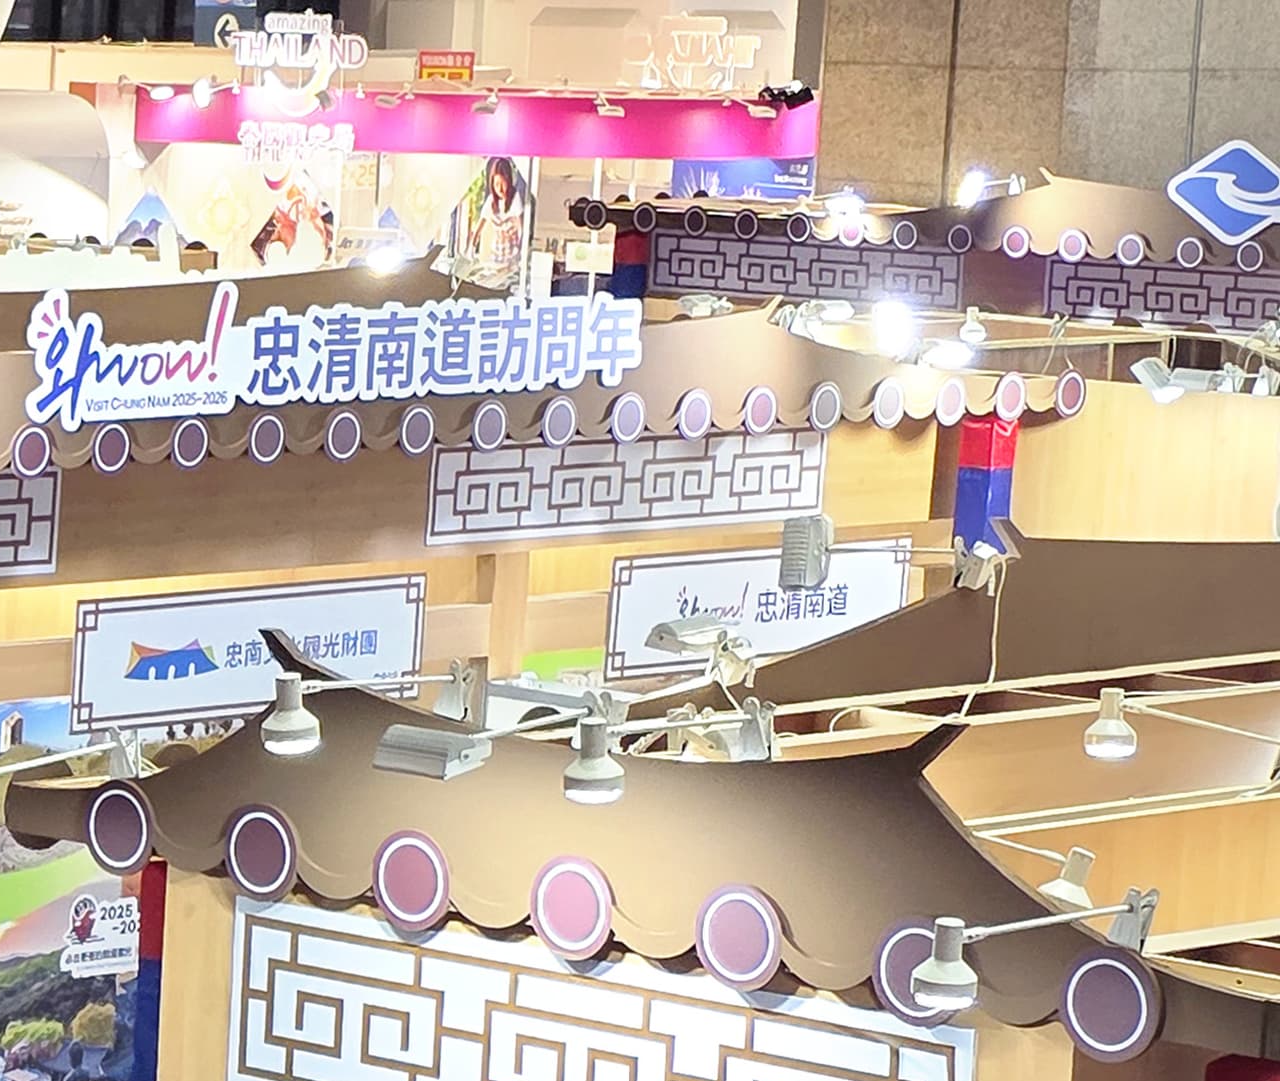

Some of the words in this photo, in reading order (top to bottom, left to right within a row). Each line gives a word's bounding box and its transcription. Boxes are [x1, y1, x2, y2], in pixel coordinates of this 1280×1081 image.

[266, 12, 331, 34] amazing
[232, 33, 367, 67] THAILAND
[246, 299, 637, 396] 忠清南道訪問年
[172, 391, 228, 407] 2025-2026
[754, 583, 849, 624] 忠清南道
[224, 629, 378, 670] 忠南觀光財團
[100, 903, 133, 920] 2025
